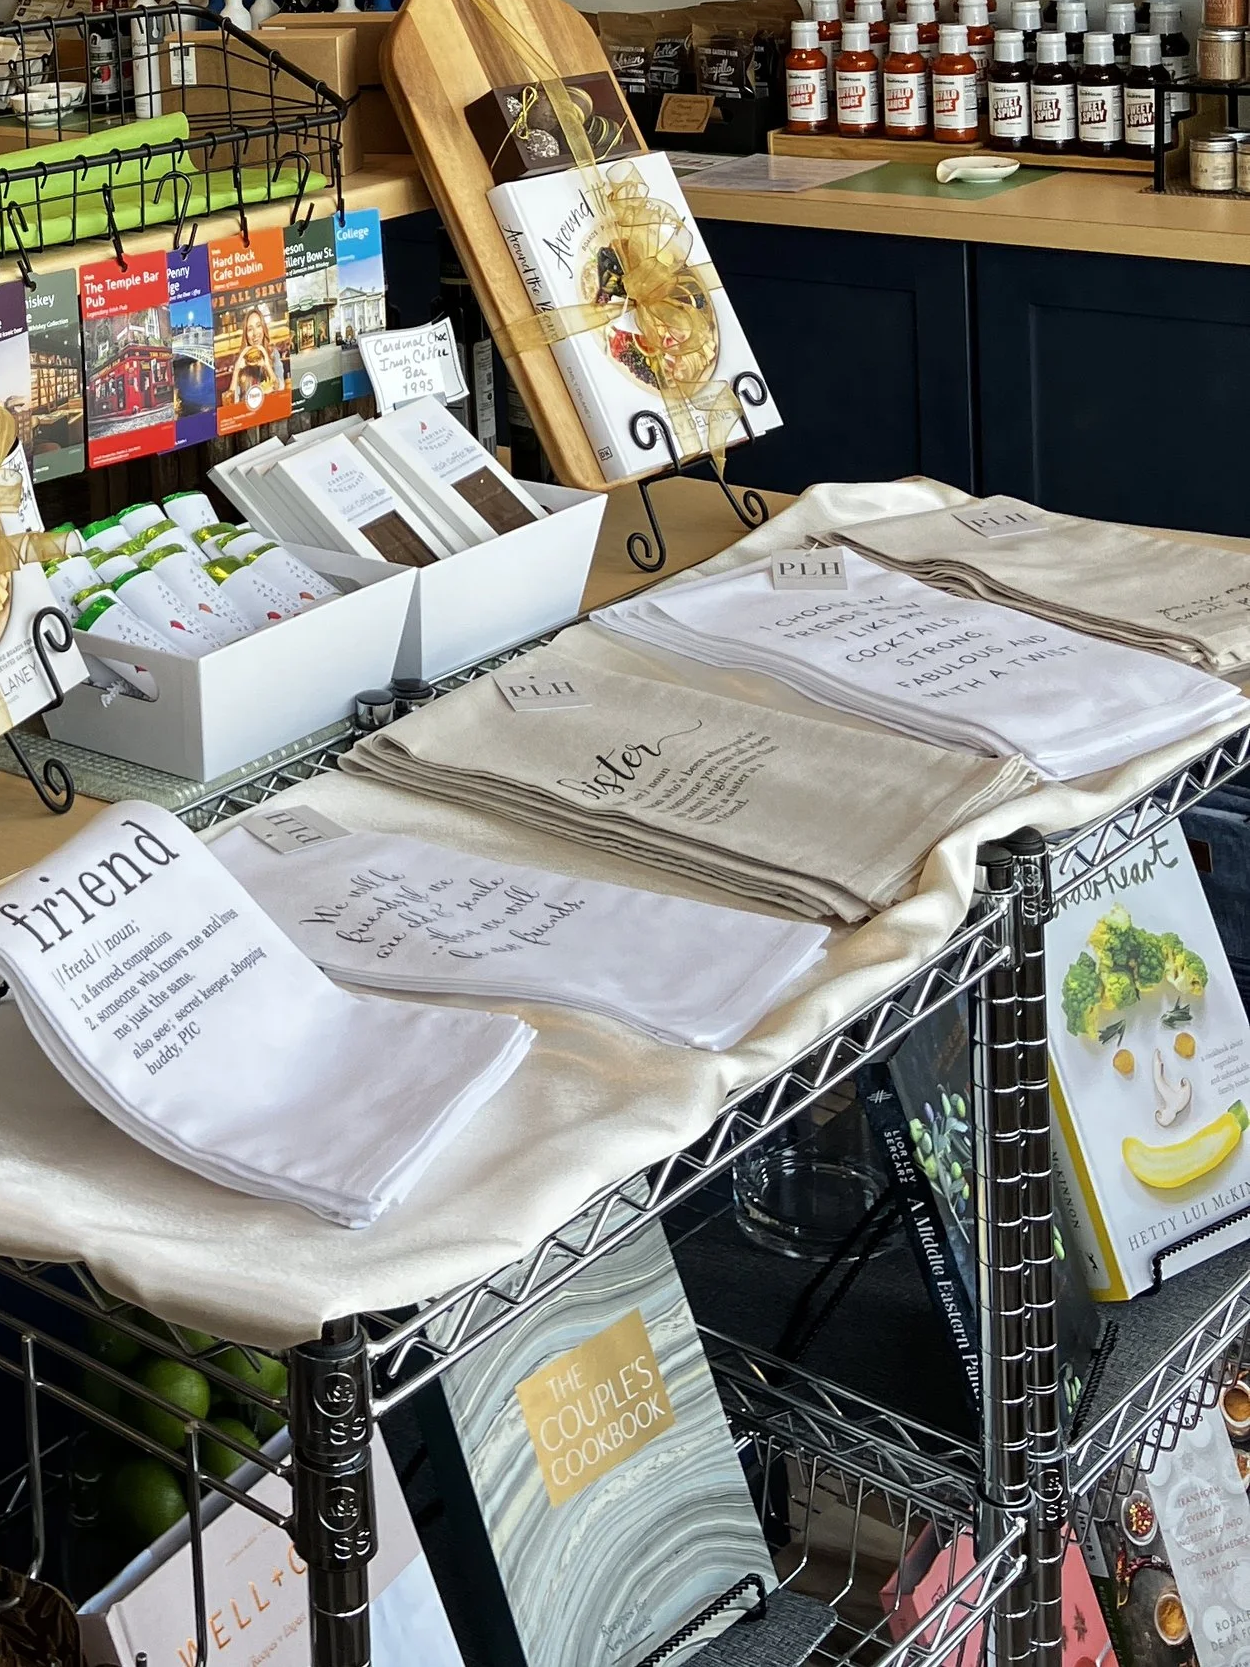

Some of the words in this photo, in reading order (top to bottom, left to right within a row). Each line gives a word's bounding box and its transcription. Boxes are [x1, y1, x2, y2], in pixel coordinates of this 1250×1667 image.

[997, 106, 1020, 118] SPICY
[1036, 109, 1059, 122] SPICY
[1082, 110, 1105, 122] SPICY
[1129, 112, 1153, 124] SPICY
[337, 226, 370, 241] College
[543, 188, 596, 279] Around
[212, 254, 233, 269] Hard
[234, 249, 255, 263] Rock
[306, 250, 322, 262] Bow
[324, 247, 334, 258] St.
[501, 223, 537, 282] Around
[84, 281, 104, 295] The
[106, 275, 141, 293] Temple
[143, 271, 160, 283] Bar
[213, 268, 233, 282] Cafe
[235, 262, 263, 278] Dublin
[86, 296, 106, 309] Pub
[230, 291, 252, 306] ALL
[46, 318, 69, 328] Collection
[374, 335, 426, 356] Cardinal
[403, 366, 428, 378] Bar
[970, 510, 1030, 531] PLH
[777, 560, 841, 577] PLH
[774, 599, 858, 629] CHOOSE
[858, 594, 891, 607] MY
[784, 607, 870, 642] FRIENDS
[848, 615, 896, 640] LIKE
[895, 644, 1004, 690] FABULOUS
[1006, 633, 1049, 649] AND
[507, 679, 577, 700] PLH
[922, 678, 987, 701] WITH
[988, 668, 1010, 680] A
[680, 757, 708, 777] been
[699, 764, 718, 782] you
[725, 771, 751, 798] sister
[264, 811, 323, 846] PLH
[0, 820, 180, 954] friend
[299, 900, 349, 926] We
[376, 932, 407, 959] are
[456, 876, 505, 912] senile
[122, 930, 173, 971] companion
[84, 1015, 99, 1032] 2.
[97, 983, 141, 1023] someone
[137, 965, 160, 989] who
[155, 945, 190, 974] knows
[186, 934, 204, 952] me
[201, 914, 223, 939] and
[217, 908, 239, 925] loves
[86, 964, 125, 999] favored
[83, 992, 92, 1004] a
[112, 1024, 133, 1041] me
[127, 1004, 154, 1030] just
[148, 989, 170, 1009] the
[165, 970, 196, 995] same.
[132, 1037, 154, 1060] also
[174, 996, 204, 1022] secret
[199, 973, 234, 1005] keeper,
[230, 945, 268, 978] shopping
[144, 1043, 183, 1076] buddy,
[177, 1020, 202, 1047] PIC
[883, 1130, 908, 1184] SERCARZ
[892, 1129, 908, 1155] LIOR
[902, 1157, 918, 1183] LEV
[907, 1197, 925, 1213] A
[1127, 1217, 1179, 1252] HETTY
[1182, 1204, 1209, 1226] LUI
[914, 1214, 945, 1277] Middle
[936, 1279, 971, 1352] Eastern
[545, 1361, 589, 1404] THE
[538, 1354, 655, 1453] COUPLE'S
[550, 1390, 666, 1488] COOKBOOK
[1177, 1484, 1222, 1508] TRANSFORM
[1186, 1504, 1222, 1525] EVERYDAY
[1224, 1516, 1244, 1532] INTO
[1180, 1549, 1208, 1567] FOODS
[1201, 1566, 1222, 1580] THAT
[1222, 1559, 1241, 1574] HEAL
